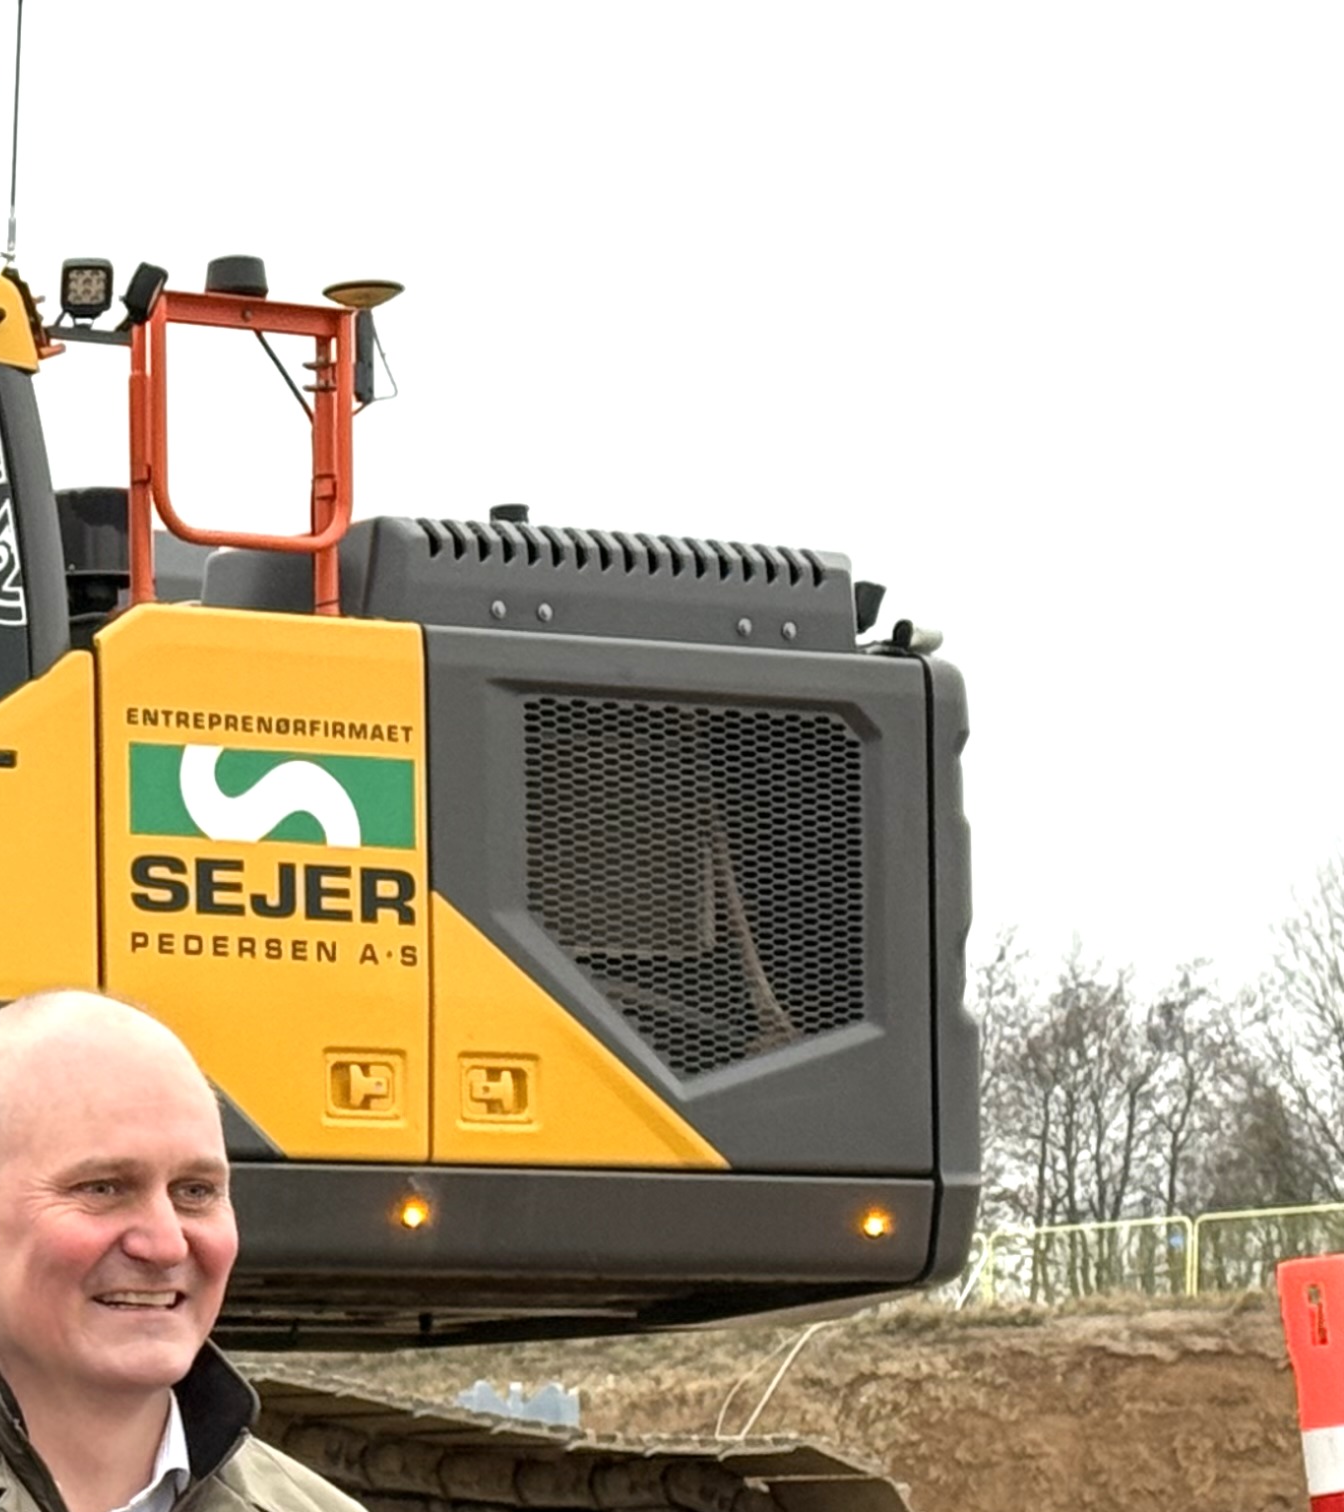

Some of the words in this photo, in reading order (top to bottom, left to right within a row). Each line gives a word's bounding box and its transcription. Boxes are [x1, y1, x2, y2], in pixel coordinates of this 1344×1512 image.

[126, 707, 413, 742] ENTREPRENØRFIRMAET
[130, 855, 417, 926] SEJER
[130, 931, 338, 963] PEDERSEN
